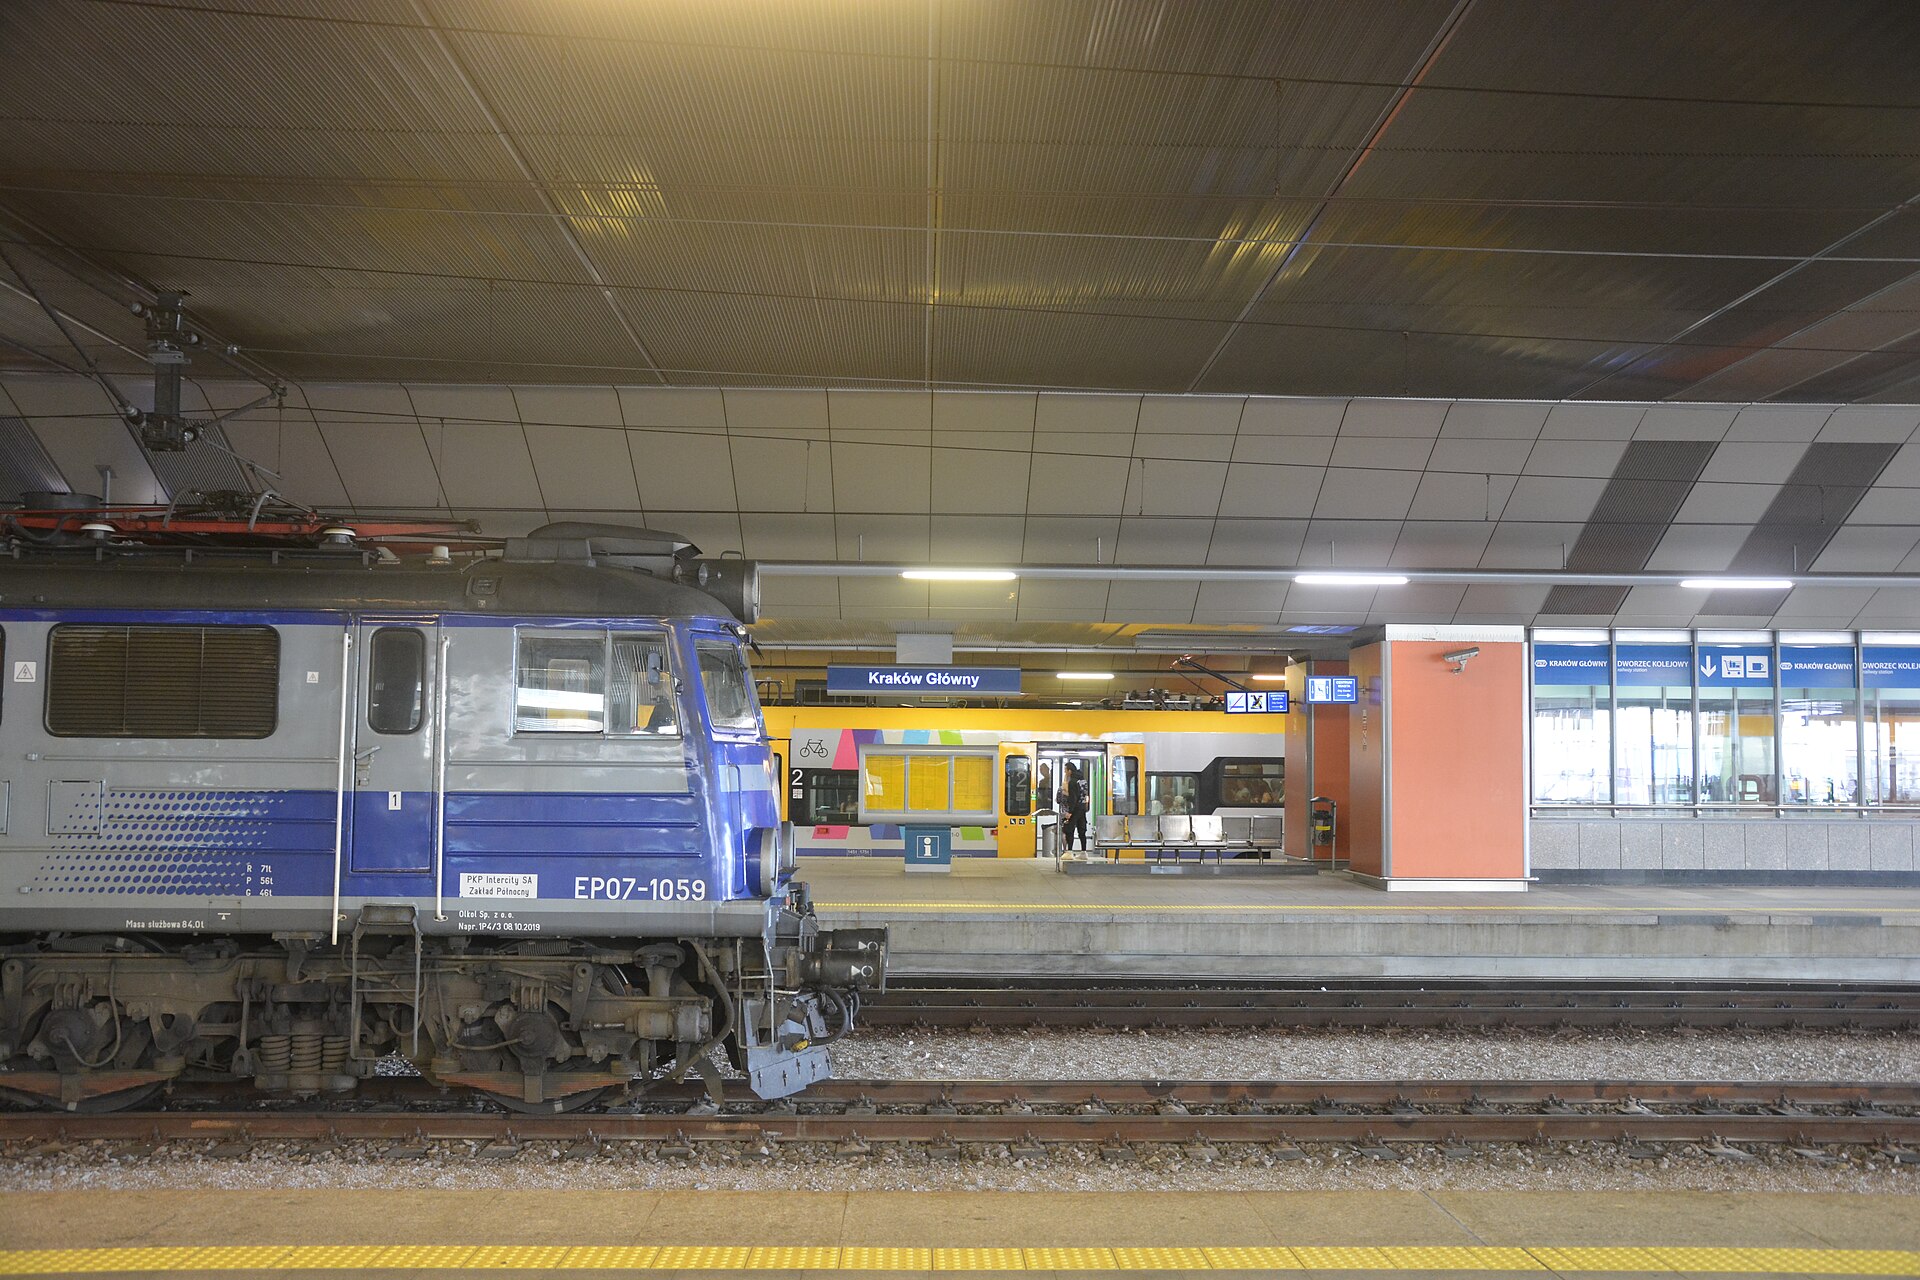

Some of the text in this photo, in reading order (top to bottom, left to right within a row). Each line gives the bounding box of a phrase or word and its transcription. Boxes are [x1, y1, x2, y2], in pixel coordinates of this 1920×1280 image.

[1549, 659, 1578, 667] KRAKÓW
[1579, 659, 1608, 667] GŁÓWNY
[1794, 662, 1824, 670] KRAKÓW
[1824, 662, 1853, 670] GŁÓWNY
[1862, 662, 1897, 670] DWORZEC
[868, 672, 980, 688] Kraków Główny
[791, 769, 803, 786] 2
[1016, 771, 1027, 787] 2
[392, 794, 397, 806] 1
[246, 864, 272, 873] R 71t
[246, 877, 274, 885] P 56t
[466, 875, 533, 885] PKP Intercity SA
[245, 889, 273, 897] G 46t
[469, 887, 530, 897] Zakład Północny
[574, 876, 706, 901] EP07-1059
[458, 910, 477, 918] Olkol
[480, 910, 490, 919] Sp.
[125, 919, 145, 928] Masa
[181, 920, 205, 928] 84.0t
[458, 922, 478, 931] Napr.
